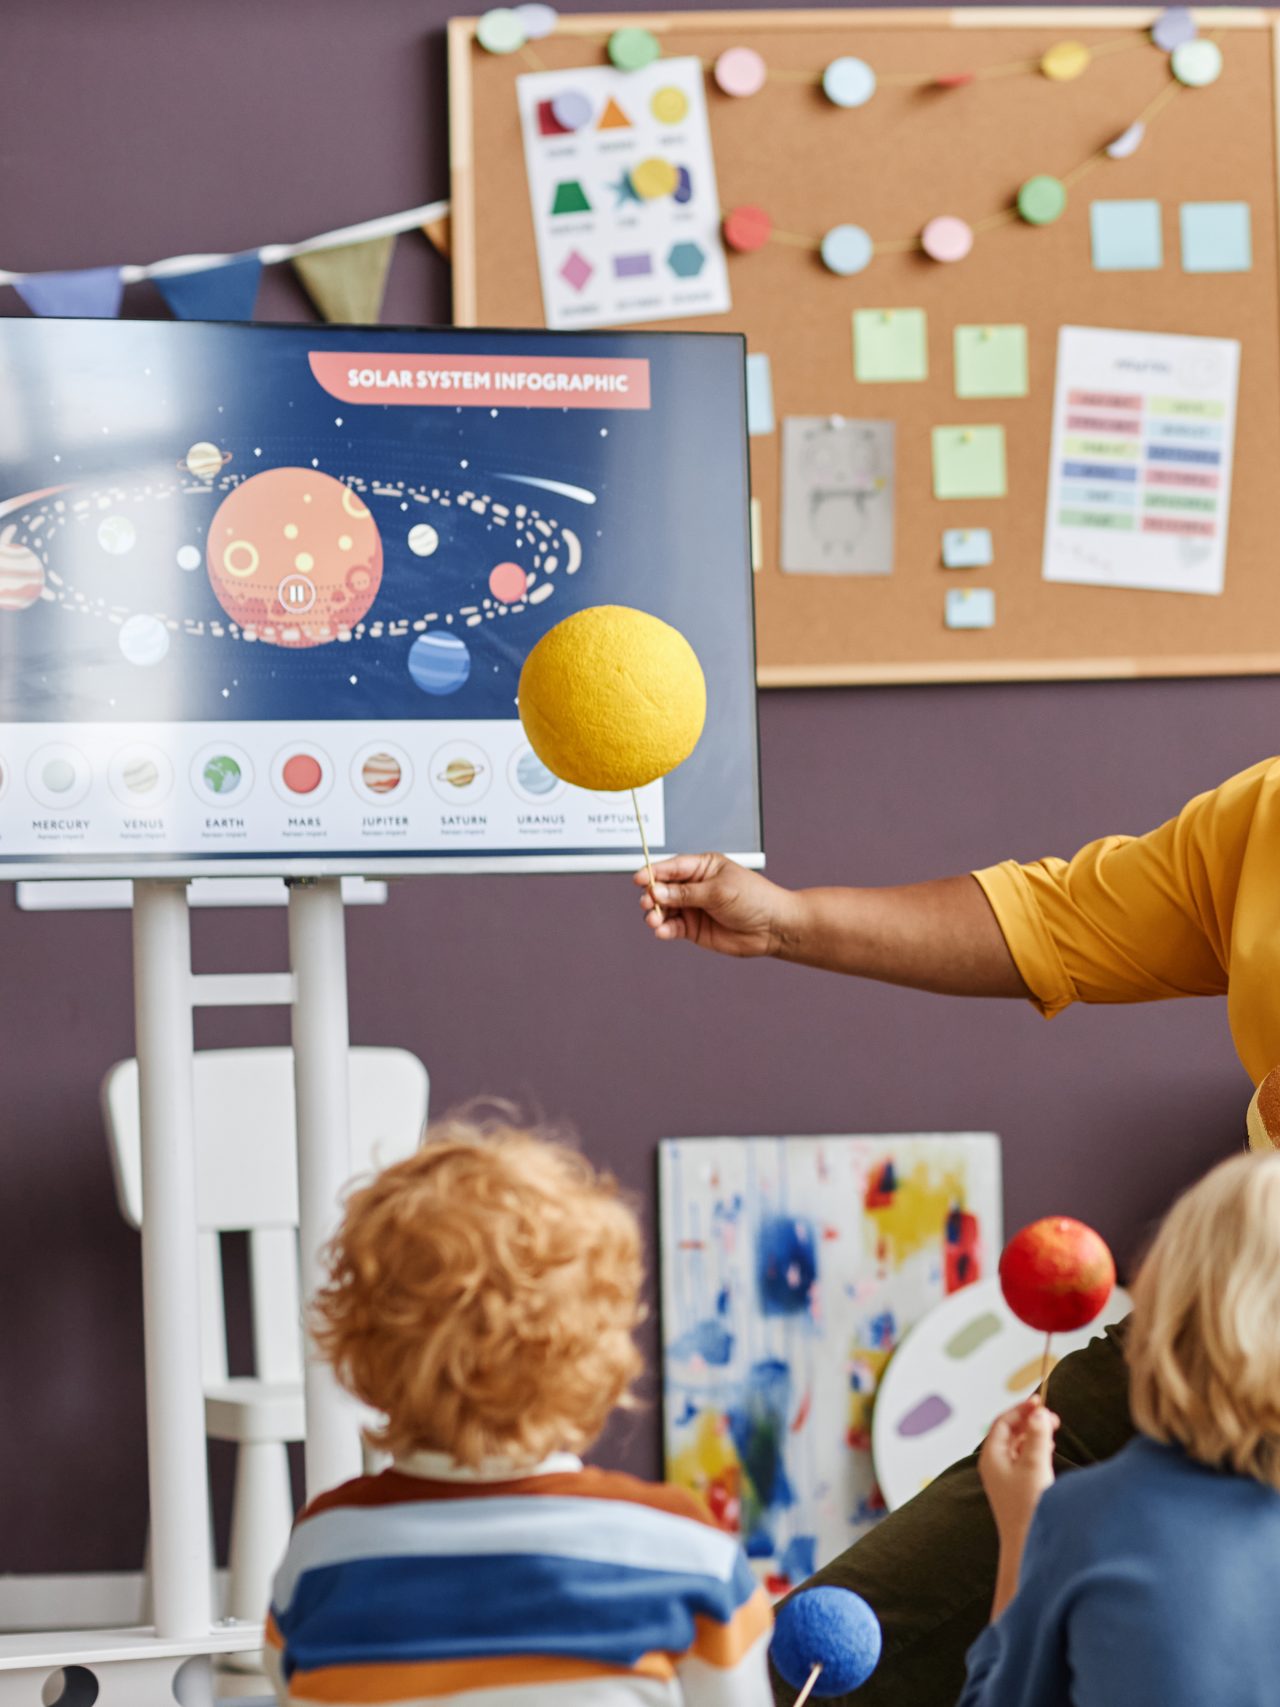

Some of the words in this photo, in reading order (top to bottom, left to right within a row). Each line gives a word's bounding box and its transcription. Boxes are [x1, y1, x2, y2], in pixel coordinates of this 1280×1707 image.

[348, 369, 413, 388] SOLAR
[416, 370, 491, 390] SYSTEM
[495, 372, 629, 392] INFOGRAPHIC
[32, 819, 90, 830] MERCURY
[123, 818, 164, 829] VENUS
[205, 818, 245, 828] EARTH
[288, 817, 321, 827] MARS
[362, 816, 409, 826] JUPITER
[441, 816, 487, 825] SATURN
[517, 815, 566, 825] URANUS
